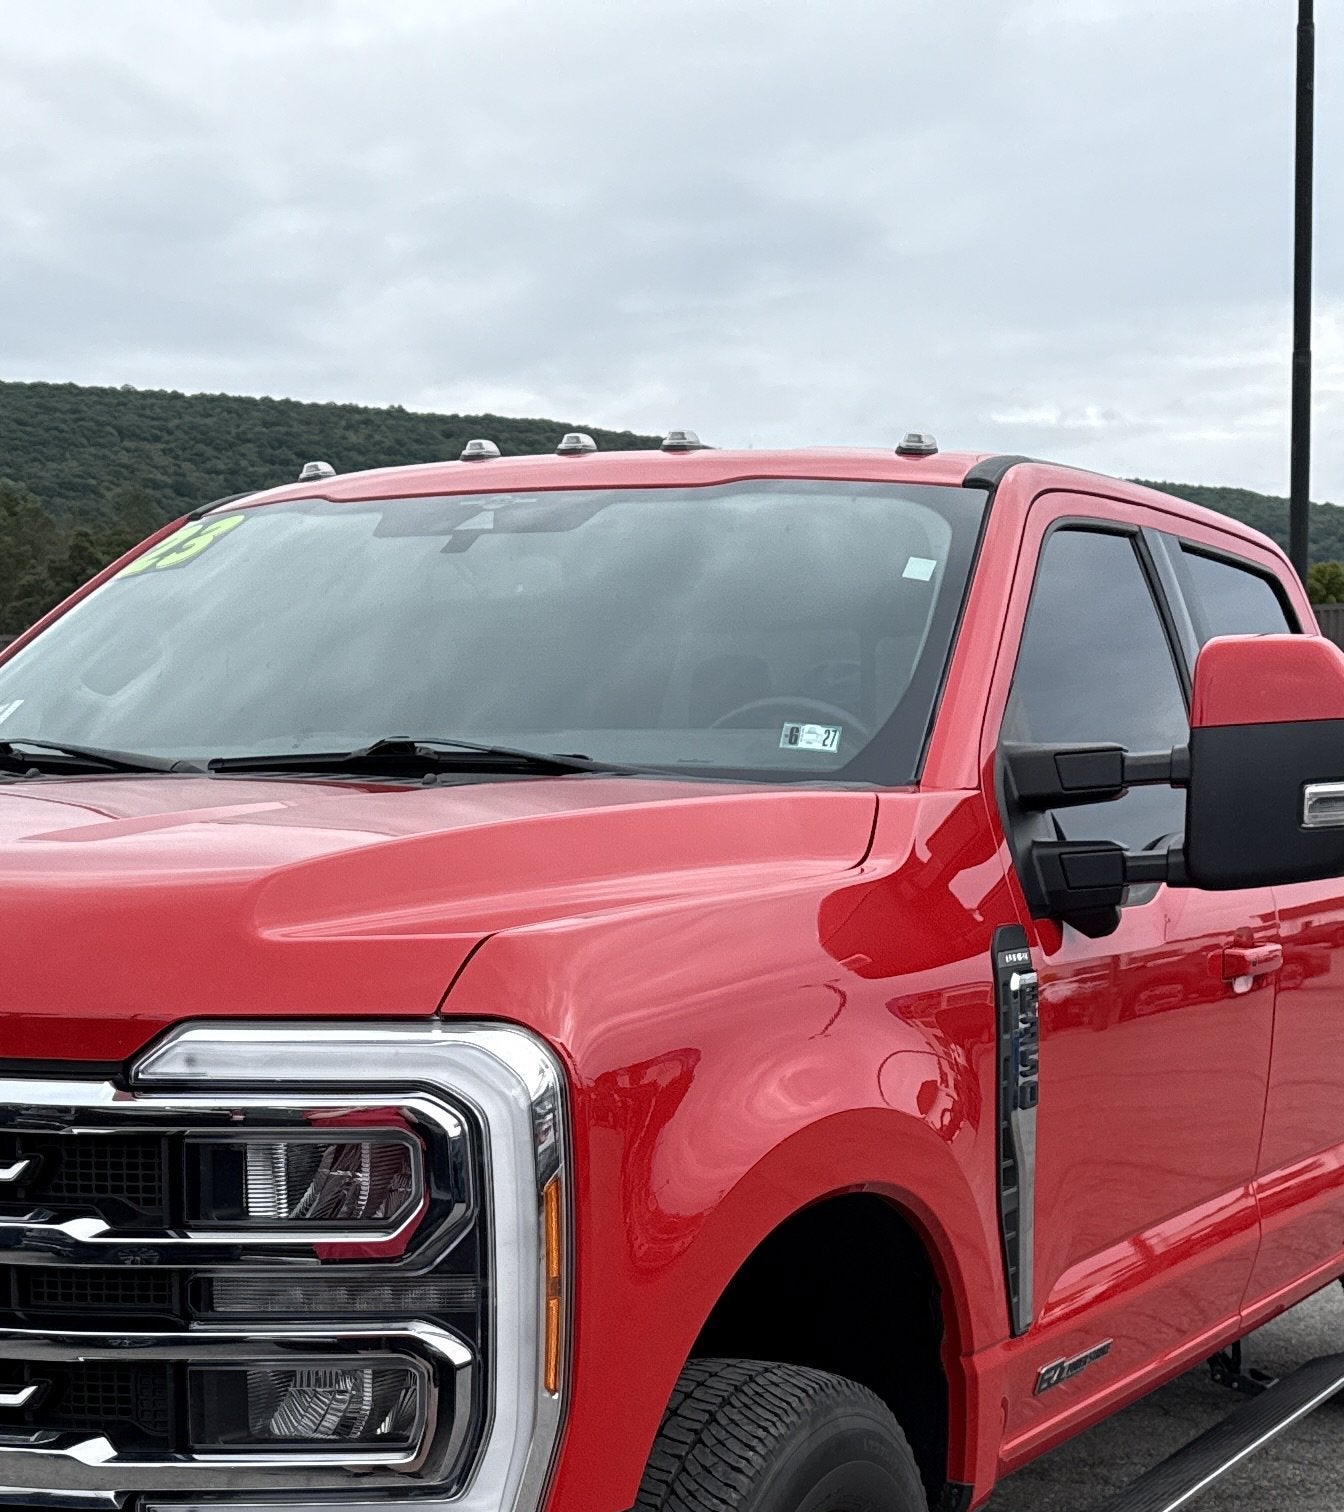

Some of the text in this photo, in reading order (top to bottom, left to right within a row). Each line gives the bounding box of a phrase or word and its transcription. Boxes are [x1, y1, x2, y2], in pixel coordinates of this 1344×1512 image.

[119, 515, 244, 577] 23
[788, 726, 837, 748] 6 27
